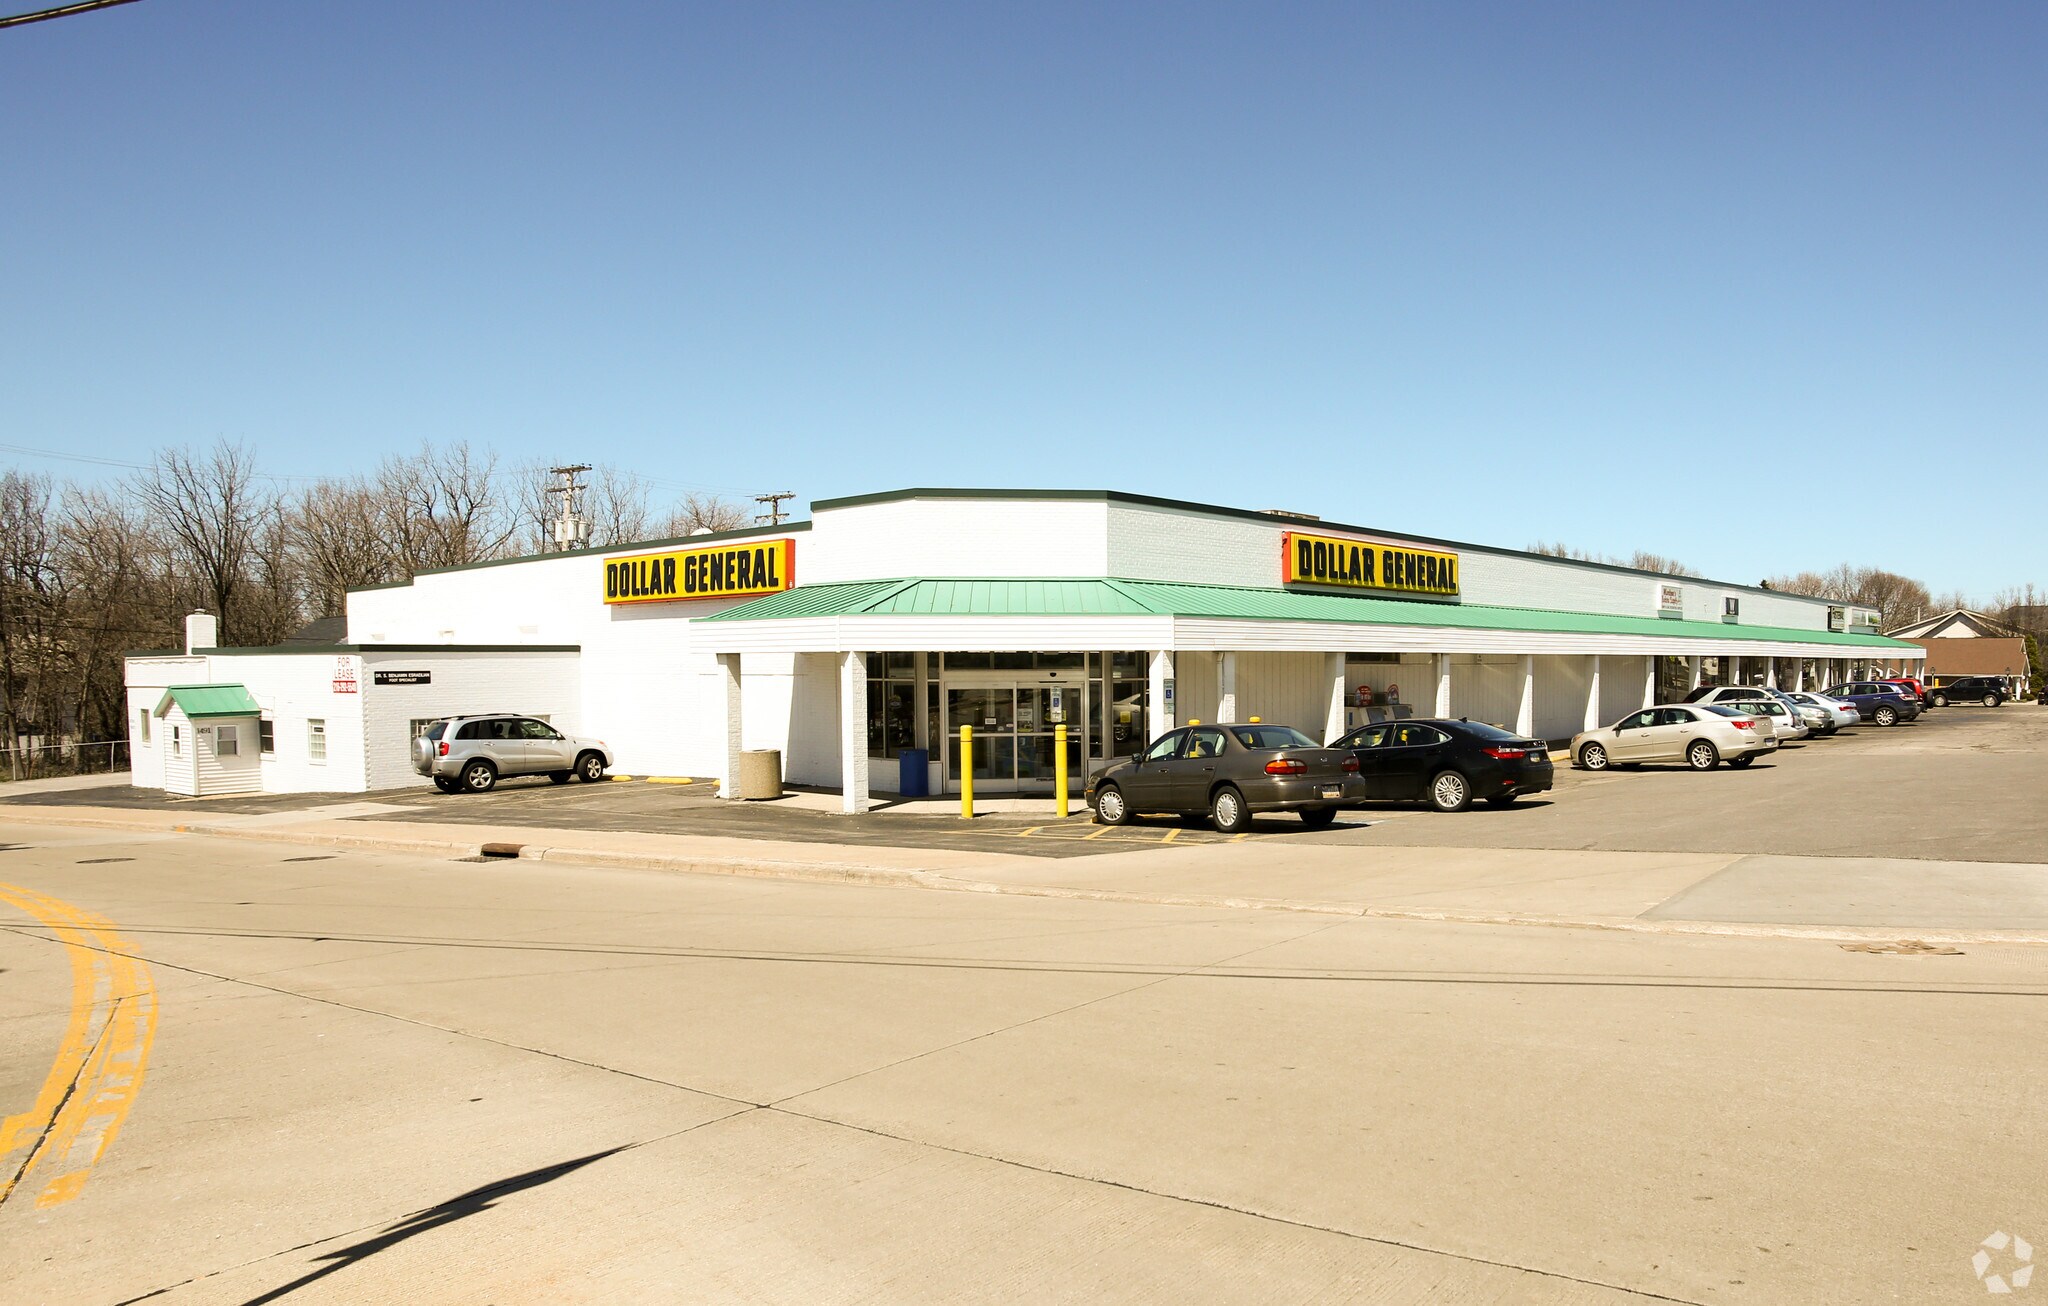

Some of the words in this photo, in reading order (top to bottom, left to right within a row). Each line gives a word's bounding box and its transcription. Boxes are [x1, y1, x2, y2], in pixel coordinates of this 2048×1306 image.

[606, 558, 676, 598] DOLLAR
[684, 547, 779, 593] GENERAL
[1298, 539, 1375, 583] DOLLAR
[1382, 550, 1457, 590] GENERAL
[334, 668, 354, 679] LEASE
[337, 657, 351, 667] FOR
